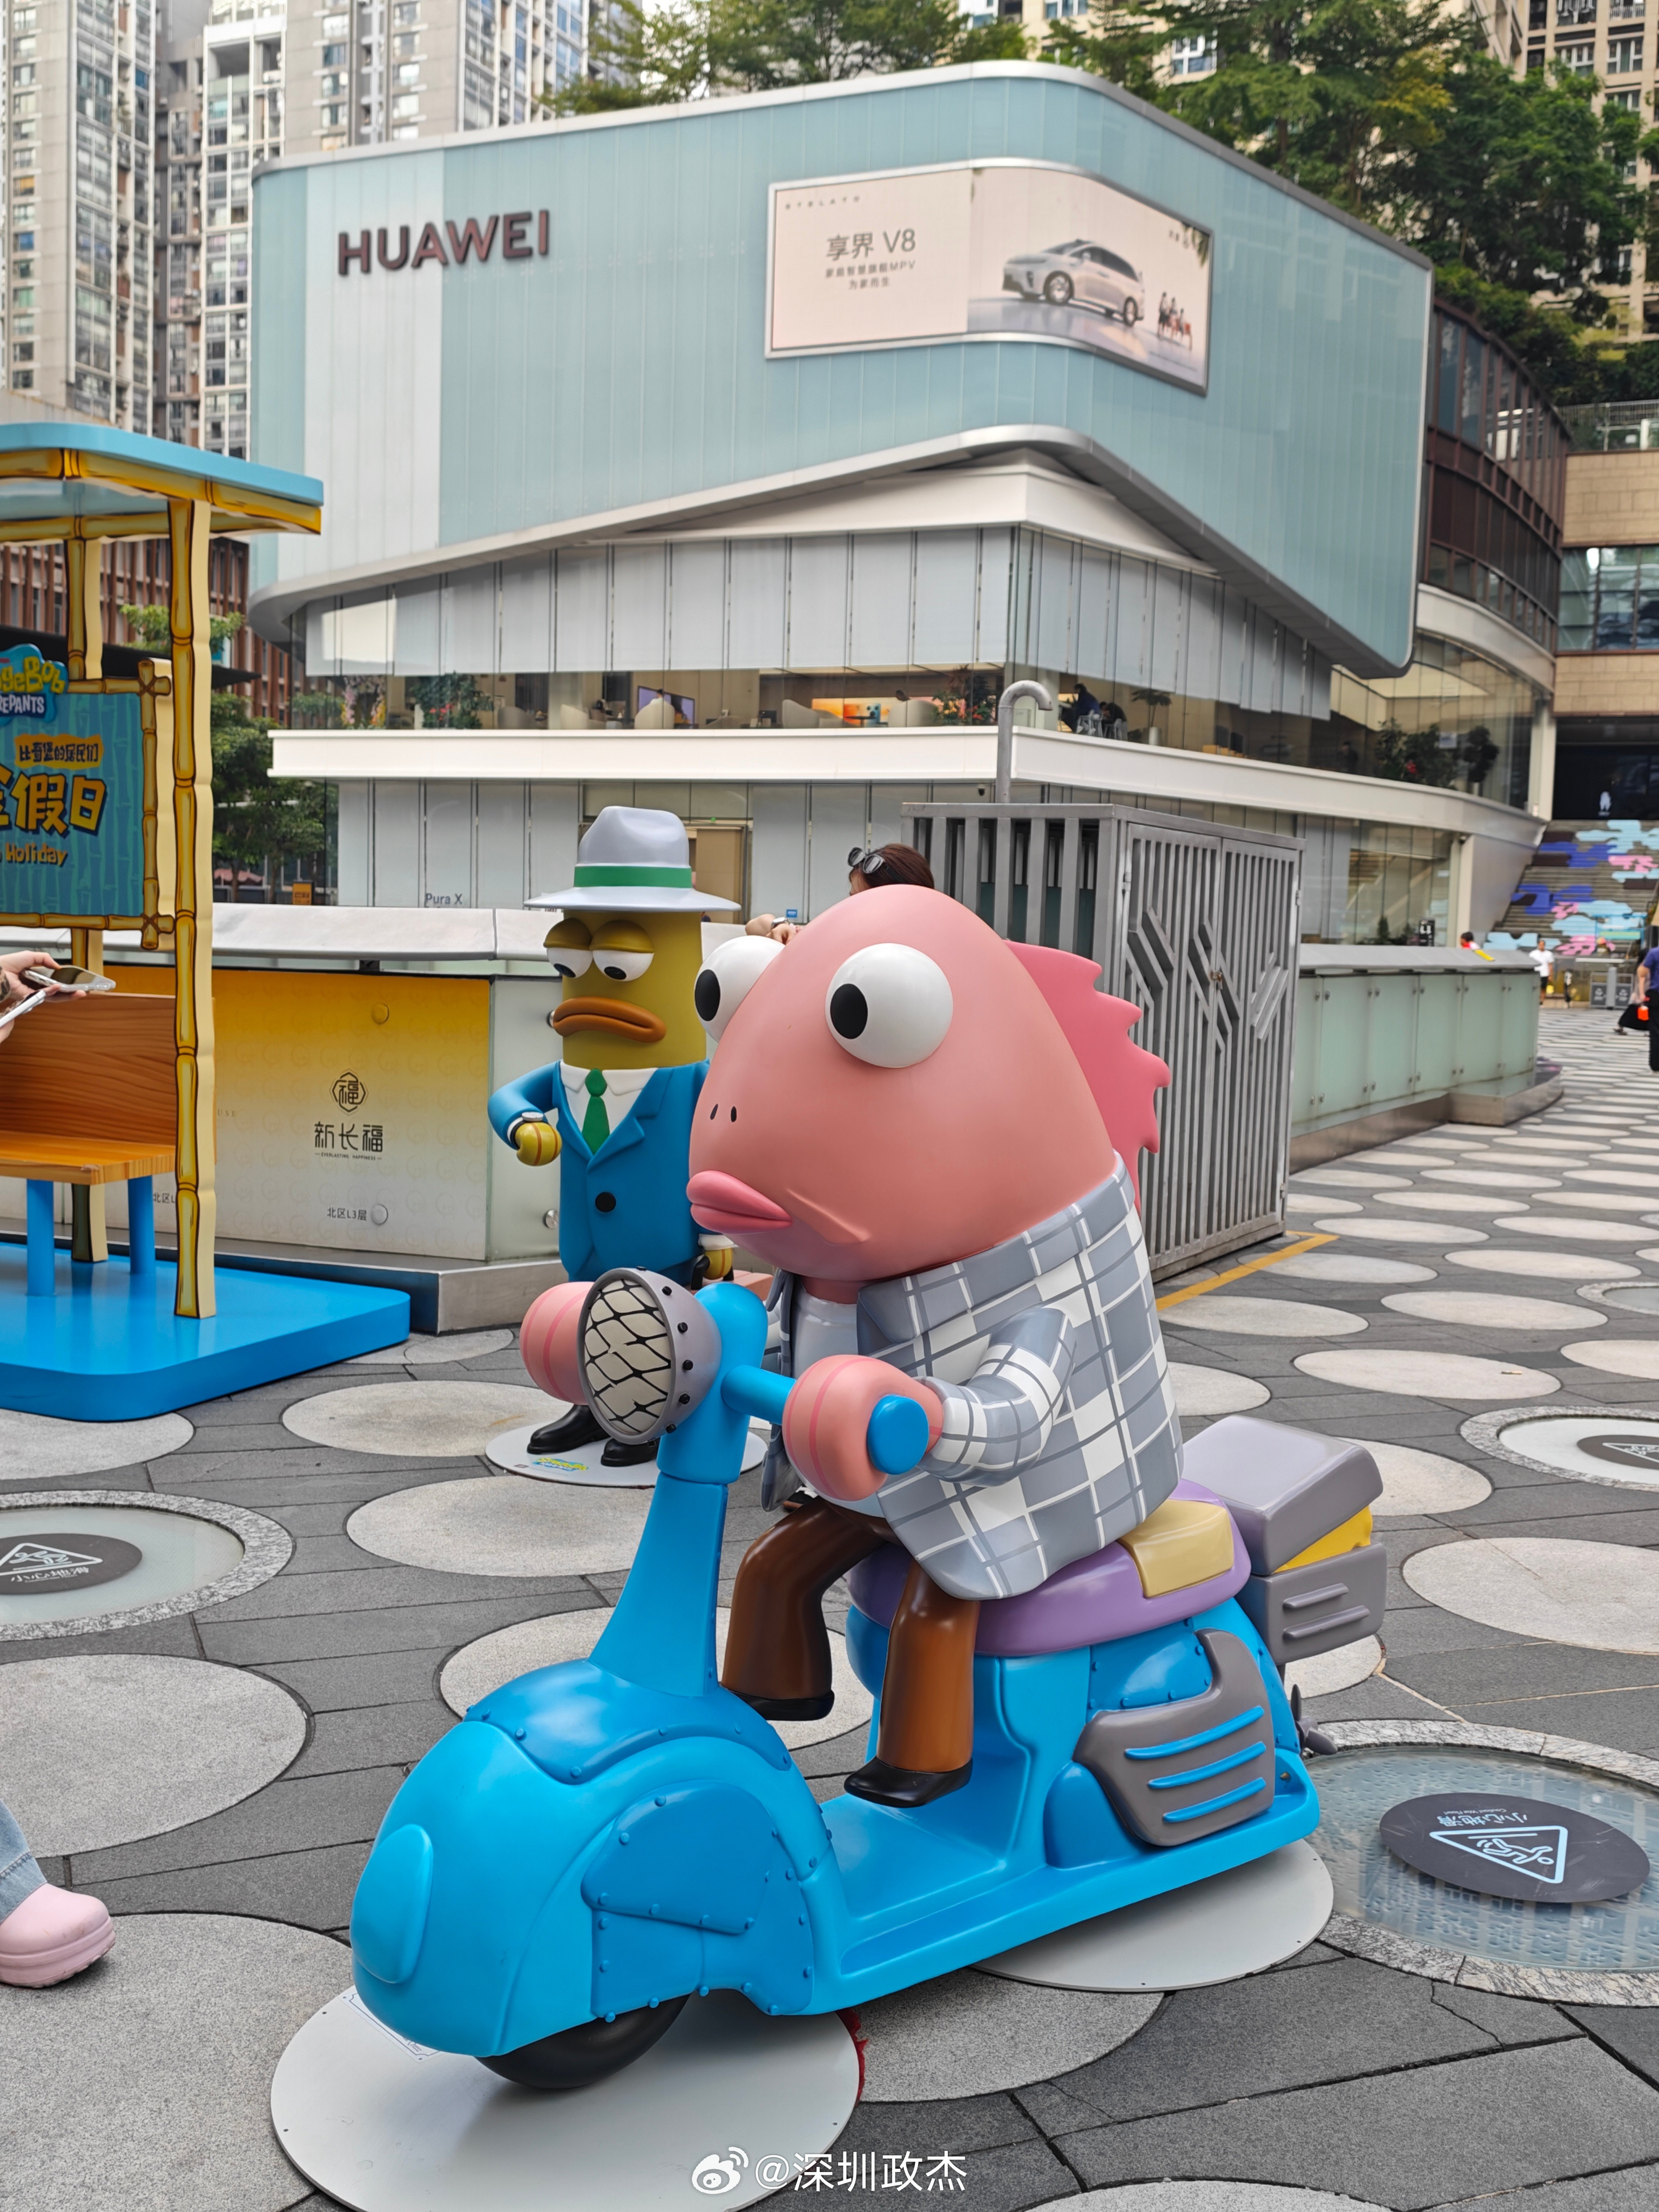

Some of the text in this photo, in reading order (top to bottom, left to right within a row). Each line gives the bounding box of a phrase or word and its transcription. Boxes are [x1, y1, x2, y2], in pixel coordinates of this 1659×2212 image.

[339, 209, 550, 276] HUAWEI
[826, 228, 916, 261] 享界 V8
[0, 694, 45, 714] EPANTS
[19, 741, 99, 762] 比奇堡的居民们
[5, 842, 68, 867] Holiday
[425, 893, 463, 905] Pura X
[314, 1121, 383, 1153] 新长福
[327, 1206, 367, 1221] 北区L3层
[1437, 1812, 1528, 1827] 小心地滑
